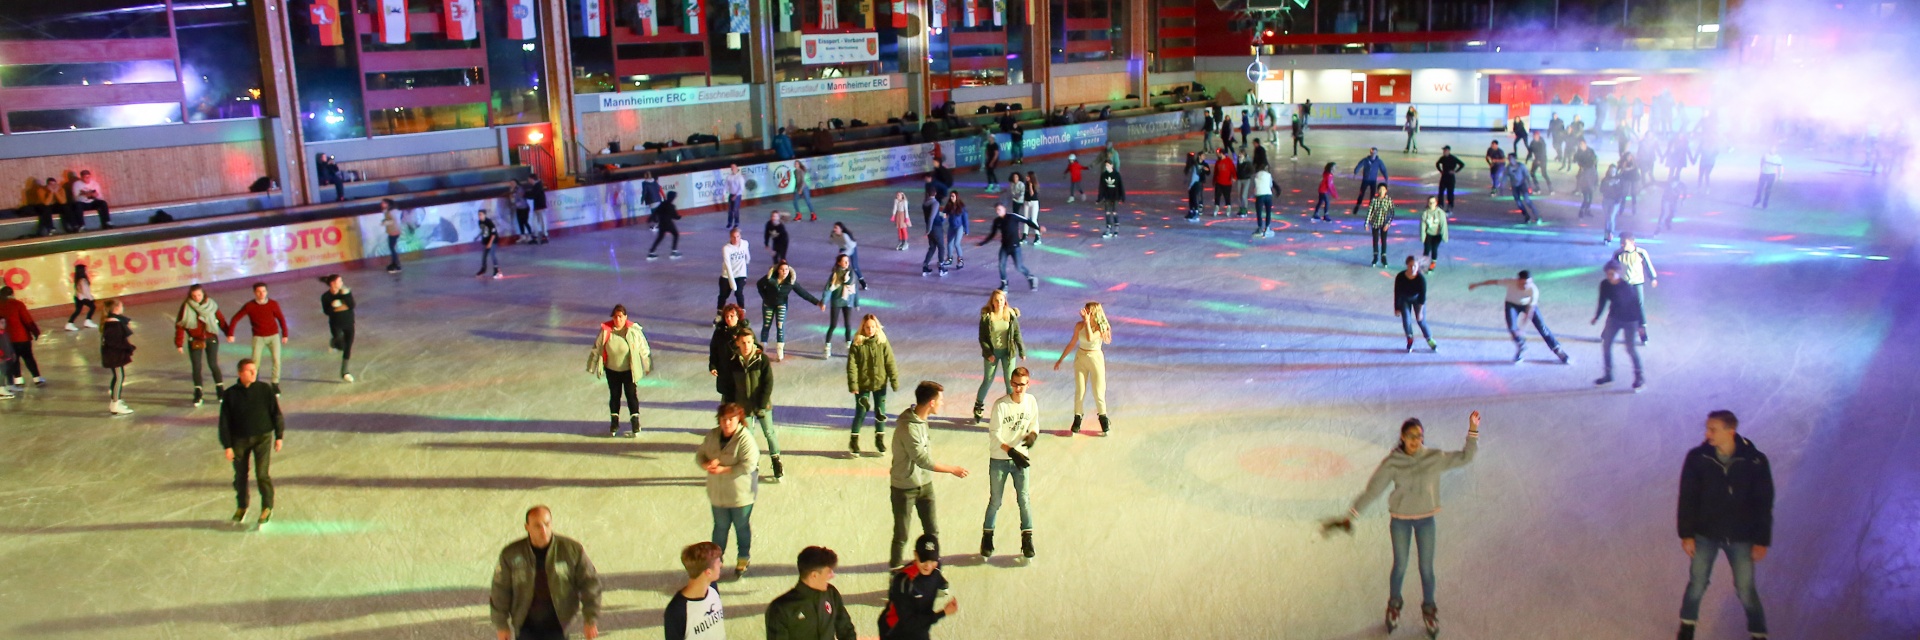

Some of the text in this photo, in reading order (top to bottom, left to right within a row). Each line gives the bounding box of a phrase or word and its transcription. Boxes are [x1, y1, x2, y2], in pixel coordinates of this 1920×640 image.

[781, 78, 888, 94] Eiskunstlauf Mannheimer ERC
[1434, 82, 1452, 92] WC
[603, 95, 664, 107] Mannheimer
[666, 92, 687, 103] ERC
[1347, 107, 1394, 116] VOLZ
[1076, 127, 1104, 137] engelhorn
[265, 226, 342, 255] LOTTO
[109, 245, 200, 277] LOTTO
[694, 609, 724, 635] HOLLISTE
